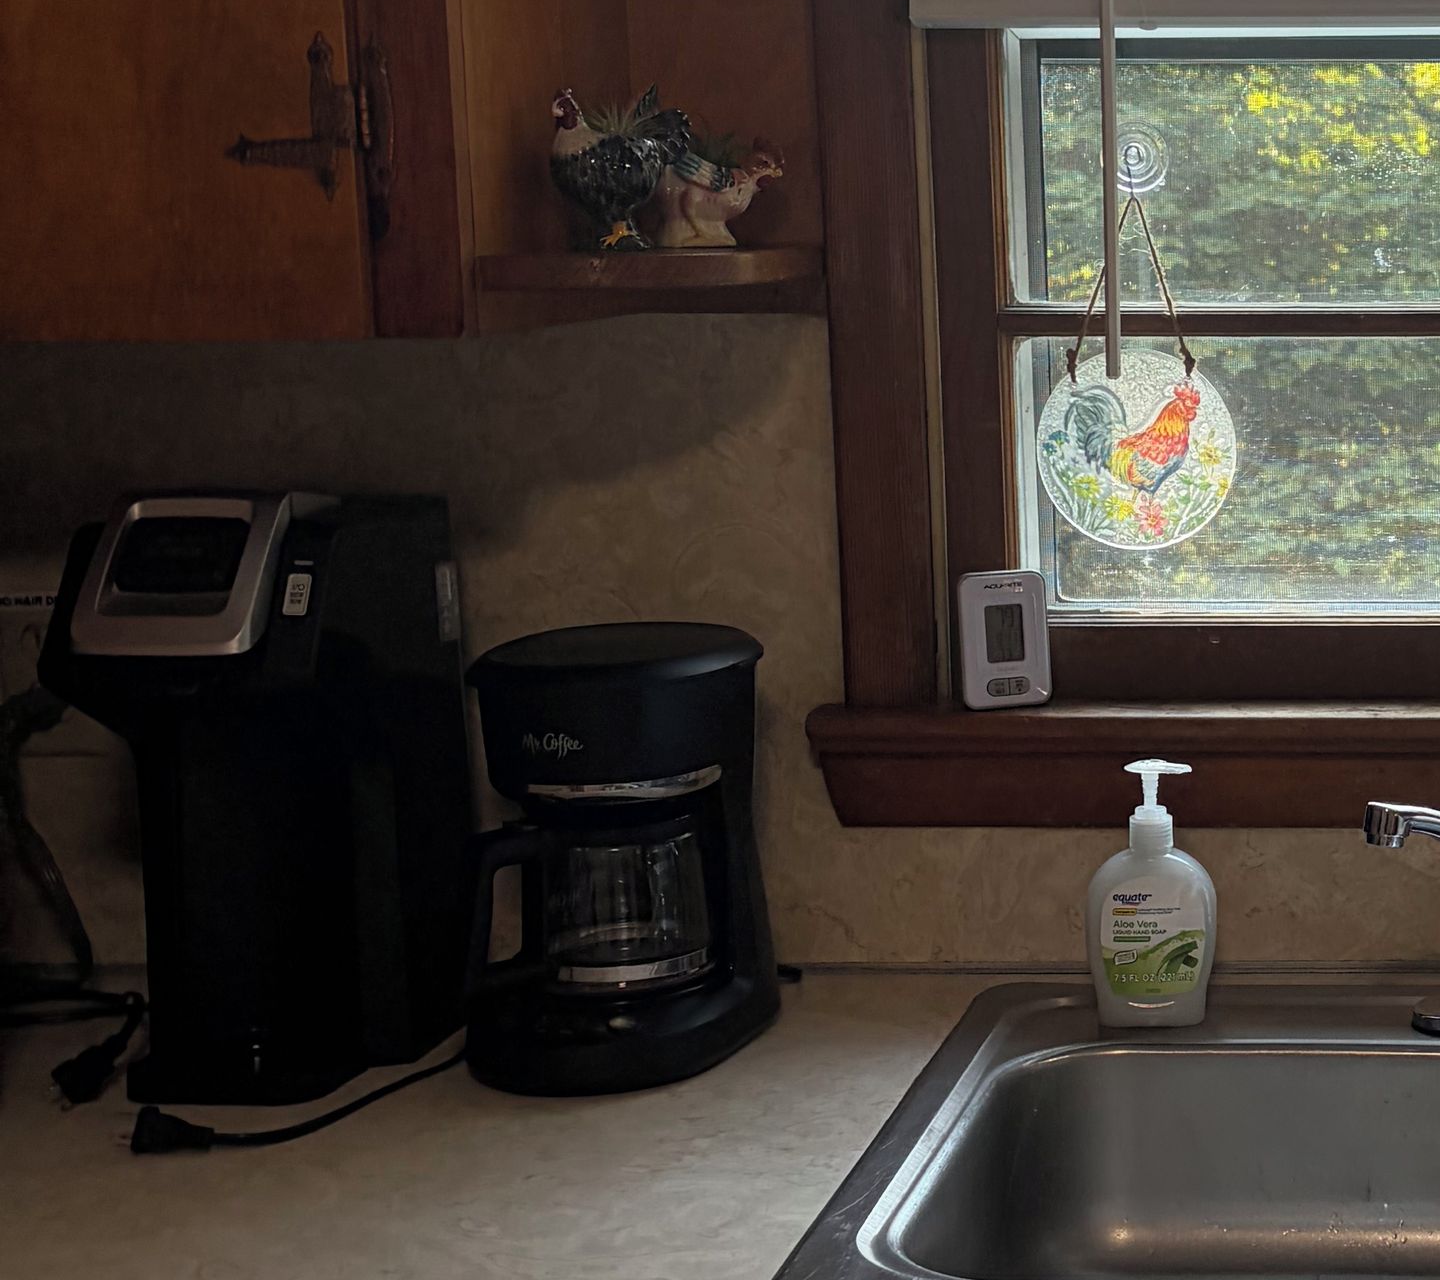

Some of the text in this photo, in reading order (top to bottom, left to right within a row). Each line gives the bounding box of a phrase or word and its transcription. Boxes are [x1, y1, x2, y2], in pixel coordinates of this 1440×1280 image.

[15, 596, 42, 605] HAIR
[543, 732, 584, 760] Coffee
[1113, 893, 1147, 904] equate
[1113, 920, 1158, 928] Aloe Vera
